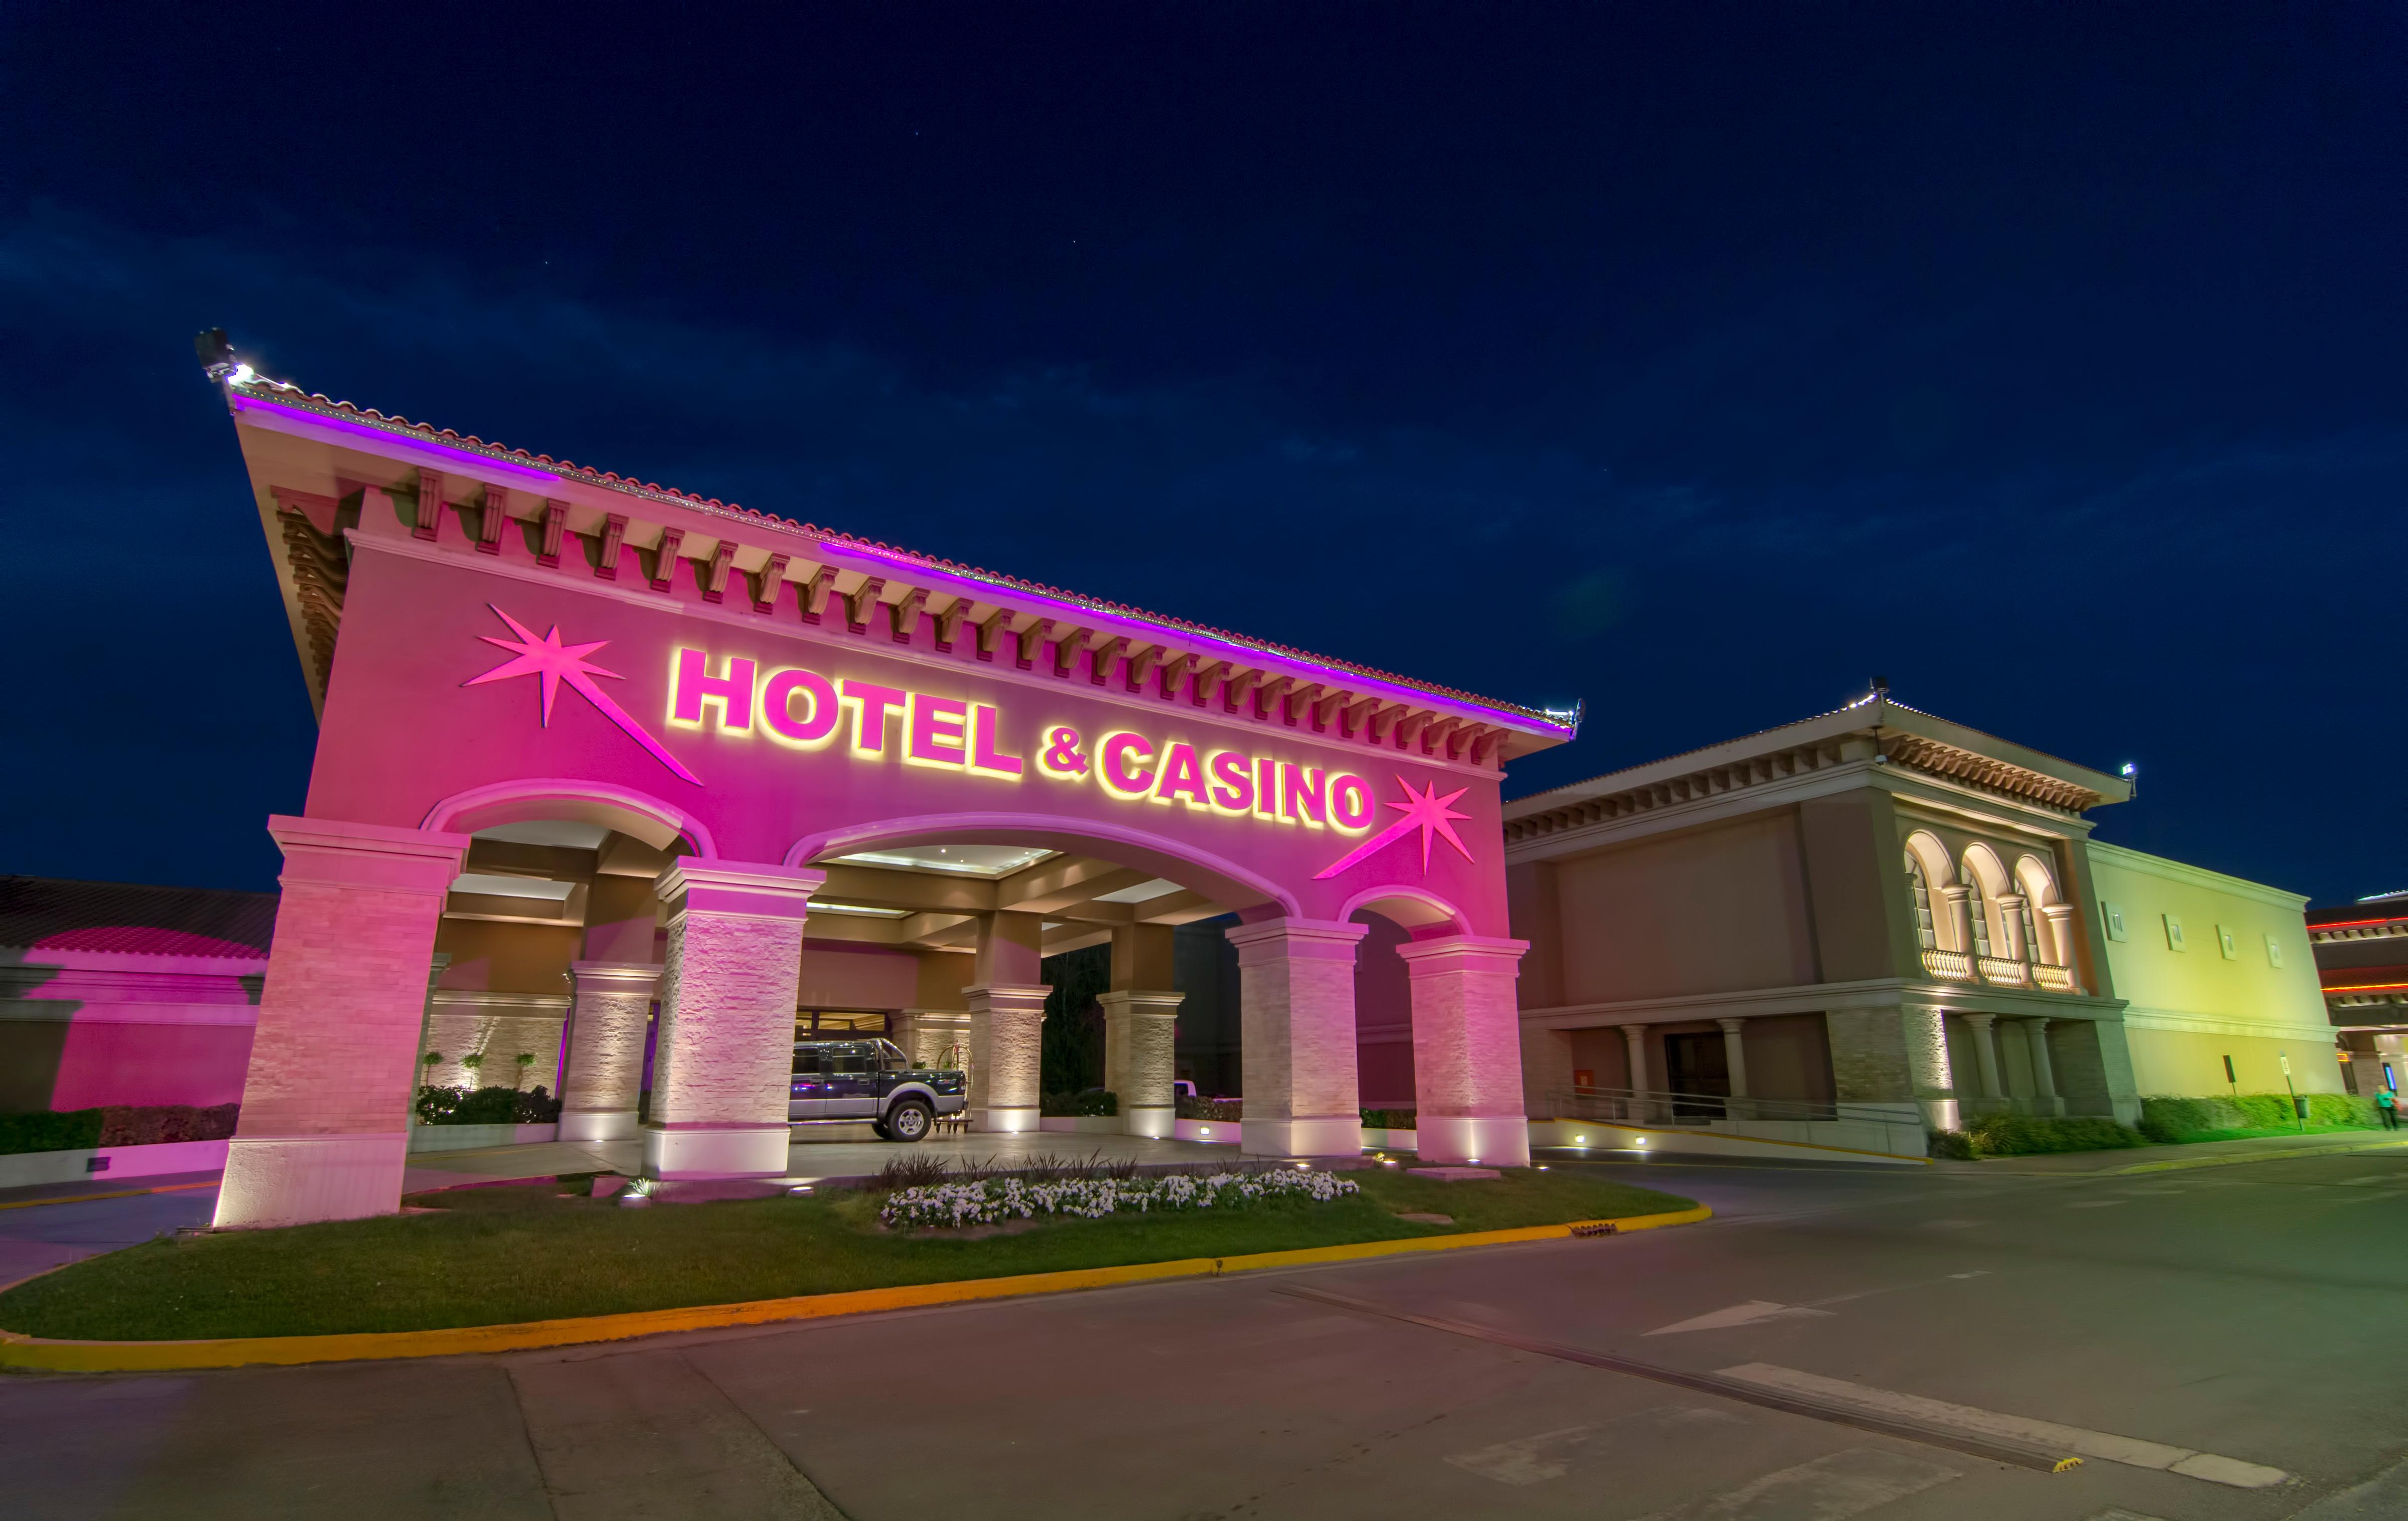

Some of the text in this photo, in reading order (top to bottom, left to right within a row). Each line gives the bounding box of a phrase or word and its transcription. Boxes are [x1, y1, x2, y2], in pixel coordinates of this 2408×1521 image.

[673, 647, 1376, 829] HOTEL & CASINO
